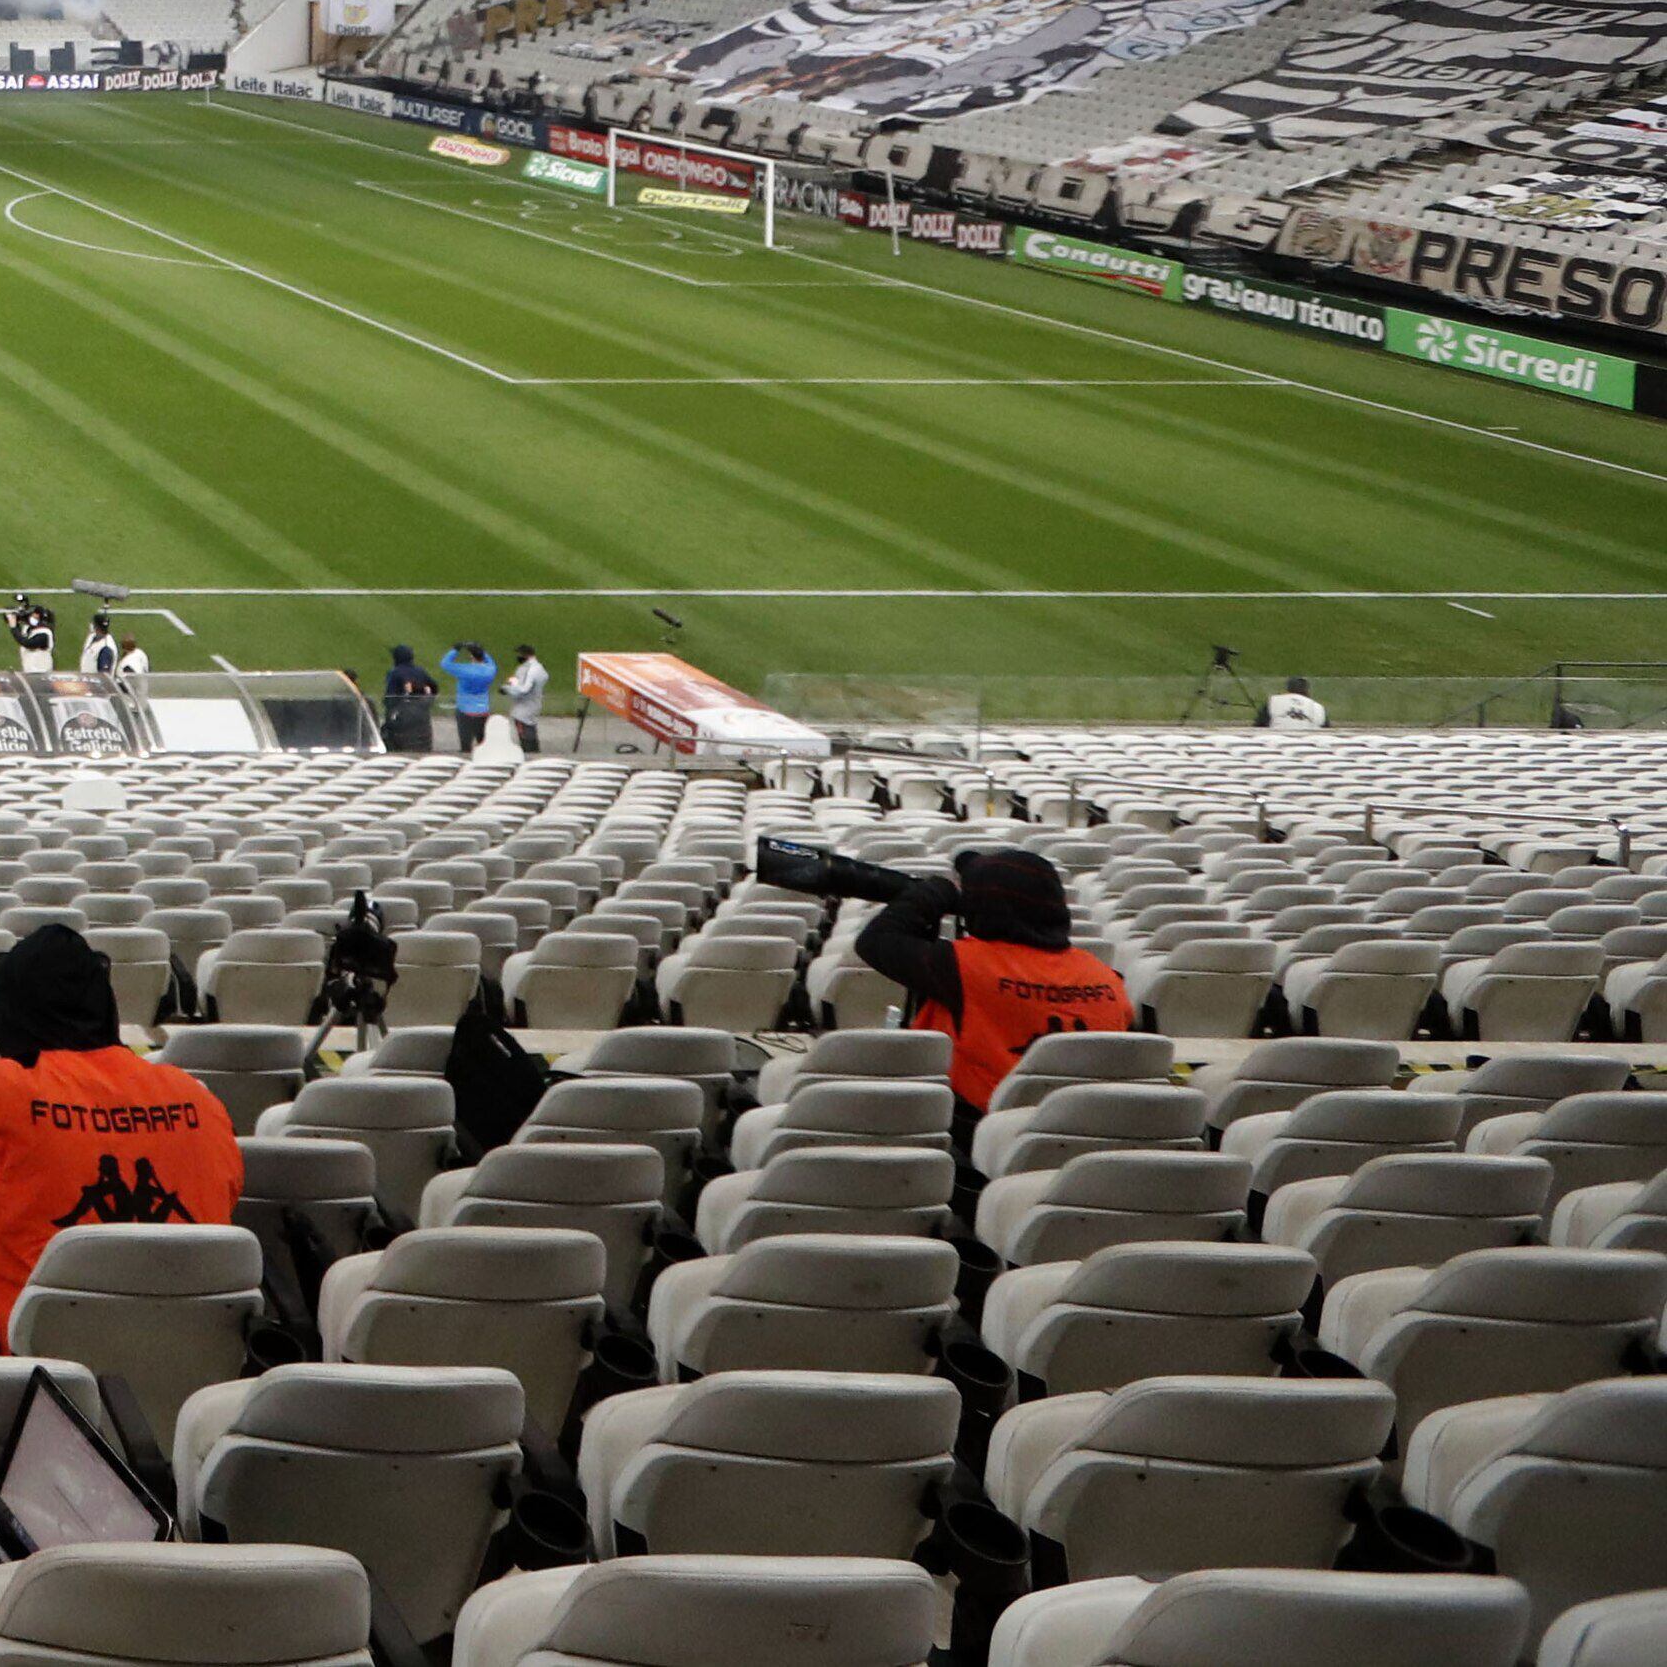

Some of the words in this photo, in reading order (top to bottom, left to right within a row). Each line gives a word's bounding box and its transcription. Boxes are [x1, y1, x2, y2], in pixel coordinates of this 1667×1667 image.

[104, 71, 141, 91] DOLLY
[142, 71, 179, 91] DOLLY
[181, 70, 218, 91] DOLLY
[233, 75, 267, 93] Leite
[273, 80, 313, 98] Italac
[604, 139, 641, 168] Lgal
[548, 160, 604, 188] Sicredi
[643, 150, 728, 188] ONBONGO
[755, 171, 838, 220] FRRACINI
[870, 202, 911, 228] DOLLY
[913, 212, 955, 239] DOLLY
[957, 222, 1003, 250] DOLLY
[1025, 233, 1170, 281] Condutti
[1412, 230, 1667, 330] PRESO
[1183, 273, 1240, 301] grau
[1240, 288, 1298, 320] GRAU
[1297, 296, 1385, 342] TÉCNICO
[1461, 333, 1599, 392] Sicredi
[61, 725, 116, 742] Estrella
[31, 1099, 199, 1134] FOTÓGRAFO
